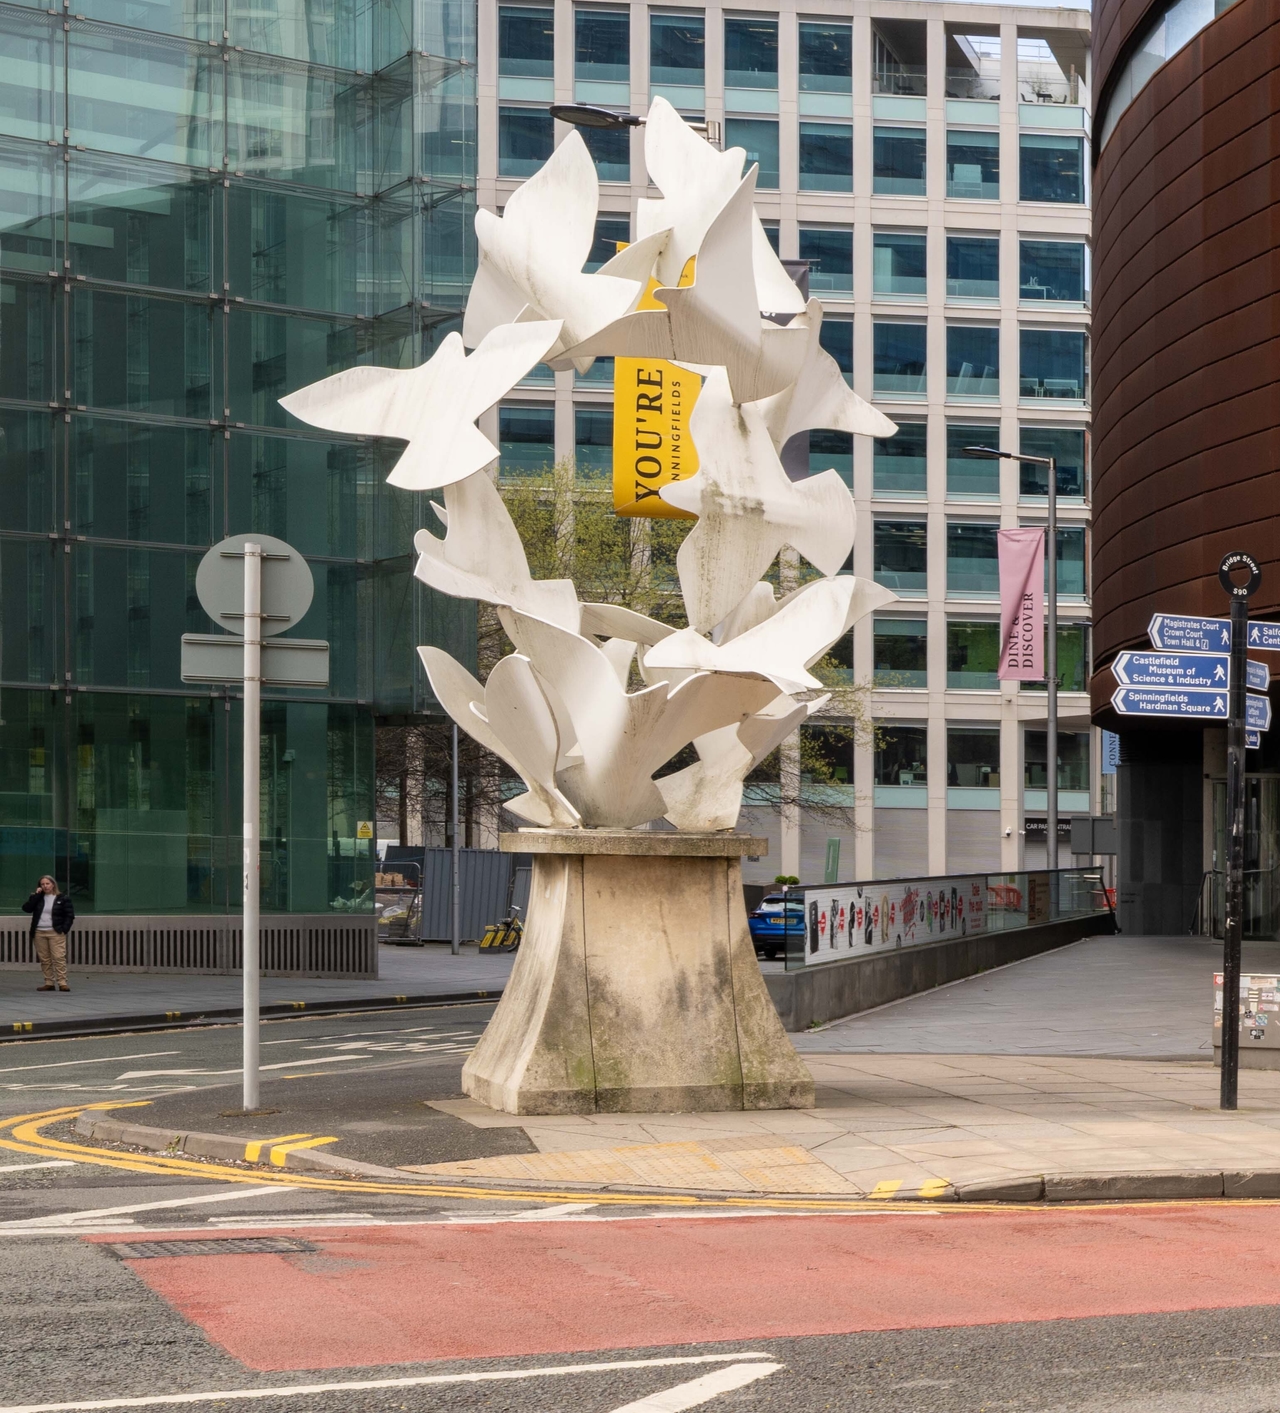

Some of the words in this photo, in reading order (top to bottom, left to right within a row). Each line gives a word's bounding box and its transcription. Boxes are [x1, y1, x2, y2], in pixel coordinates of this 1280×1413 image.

[635, 368, 663, 503] YOU'RE
[671, 381, 681, 481] NNINGFIELDS
[1222, 555, 1241, 571] Bridge
[1242, 555, 1259, 574] Street
[1164, 619, 1200, 630] Magistrates
[1201, 621, 1219, 630] Court
[1022, 592, 1034, 669] DISCOVER
[1164, 628, 1183, 637] Crown
[1184, 630, 1203, 638] Court
[1164, 637, 1180, 645] Town
[1181, 639, 1194, 647] Hall
[1008, 630, 1019, 669] DINE
[1133, 656, 1179, 666] Castlefield
[1149, 666, 1184, 675] Museum
[1187, 667, 1196, 675] of
[1133, 675, 1166, 683] Science
[1168, 675, 1174, 683] &
[1177, 676, 1212, 686] Industry
[1128, 692, 1188, 703] Spinningfields
[1140, 702, 1178, 711] Hardman
[1180, 703, 1211, 713] Square
